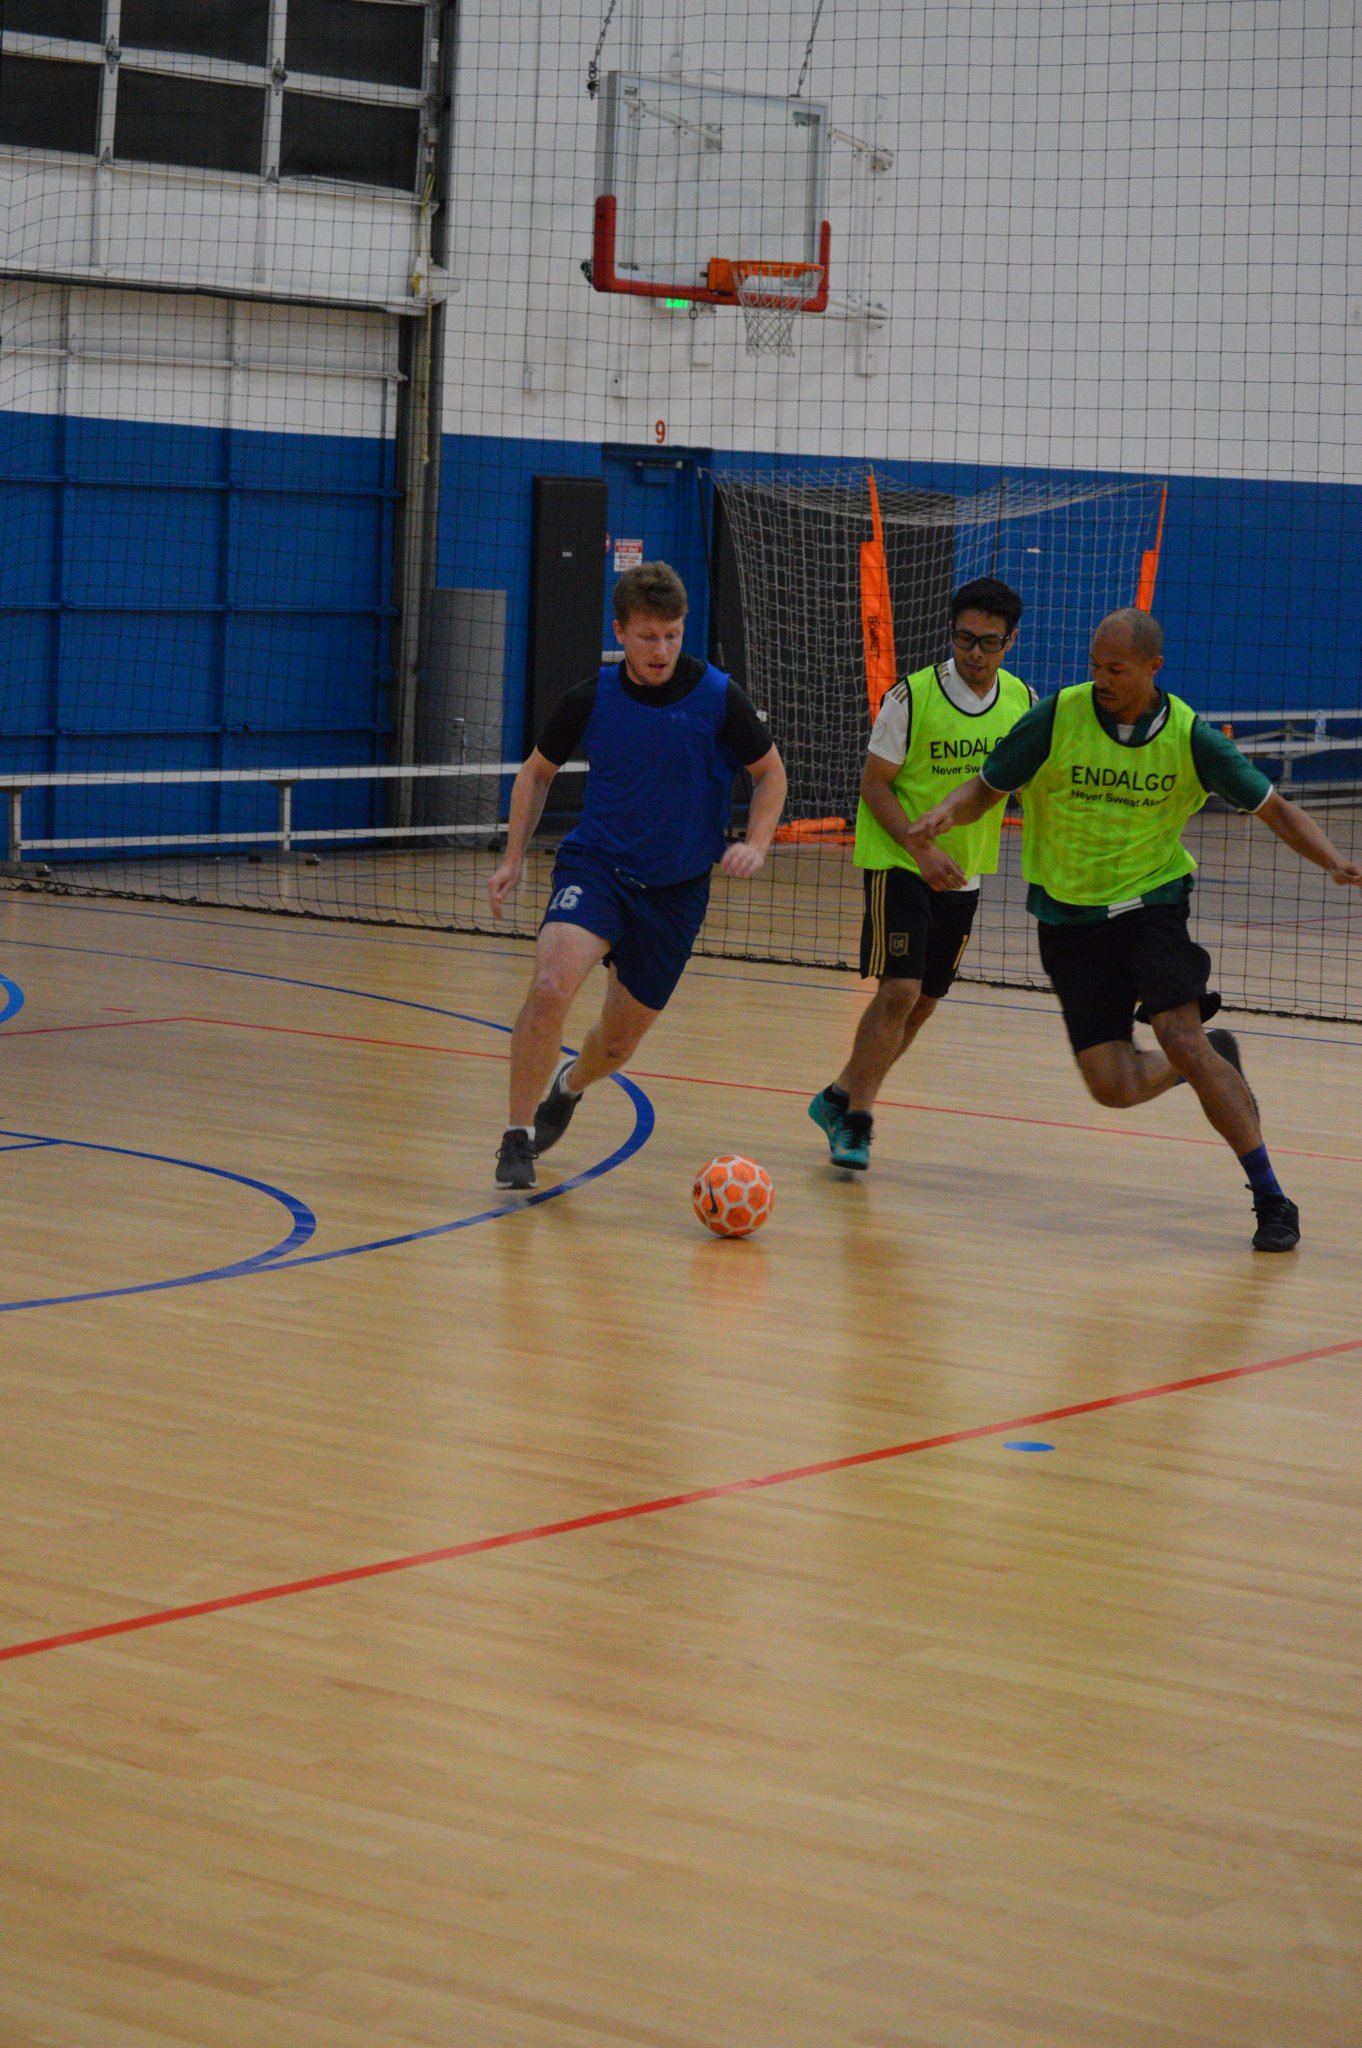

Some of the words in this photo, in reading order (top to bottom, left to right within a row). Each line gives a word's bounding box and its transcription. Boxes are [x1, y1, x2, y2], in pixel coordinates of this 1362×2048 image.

[655, 419, 666, 444] 9
[930, 736, 1004, 759] ENDAL
[932, 765, 963, 775] Never
[1071, 765, 1177, 792] ENDALGO
[1105, 793, 1140, 807] Sweat
